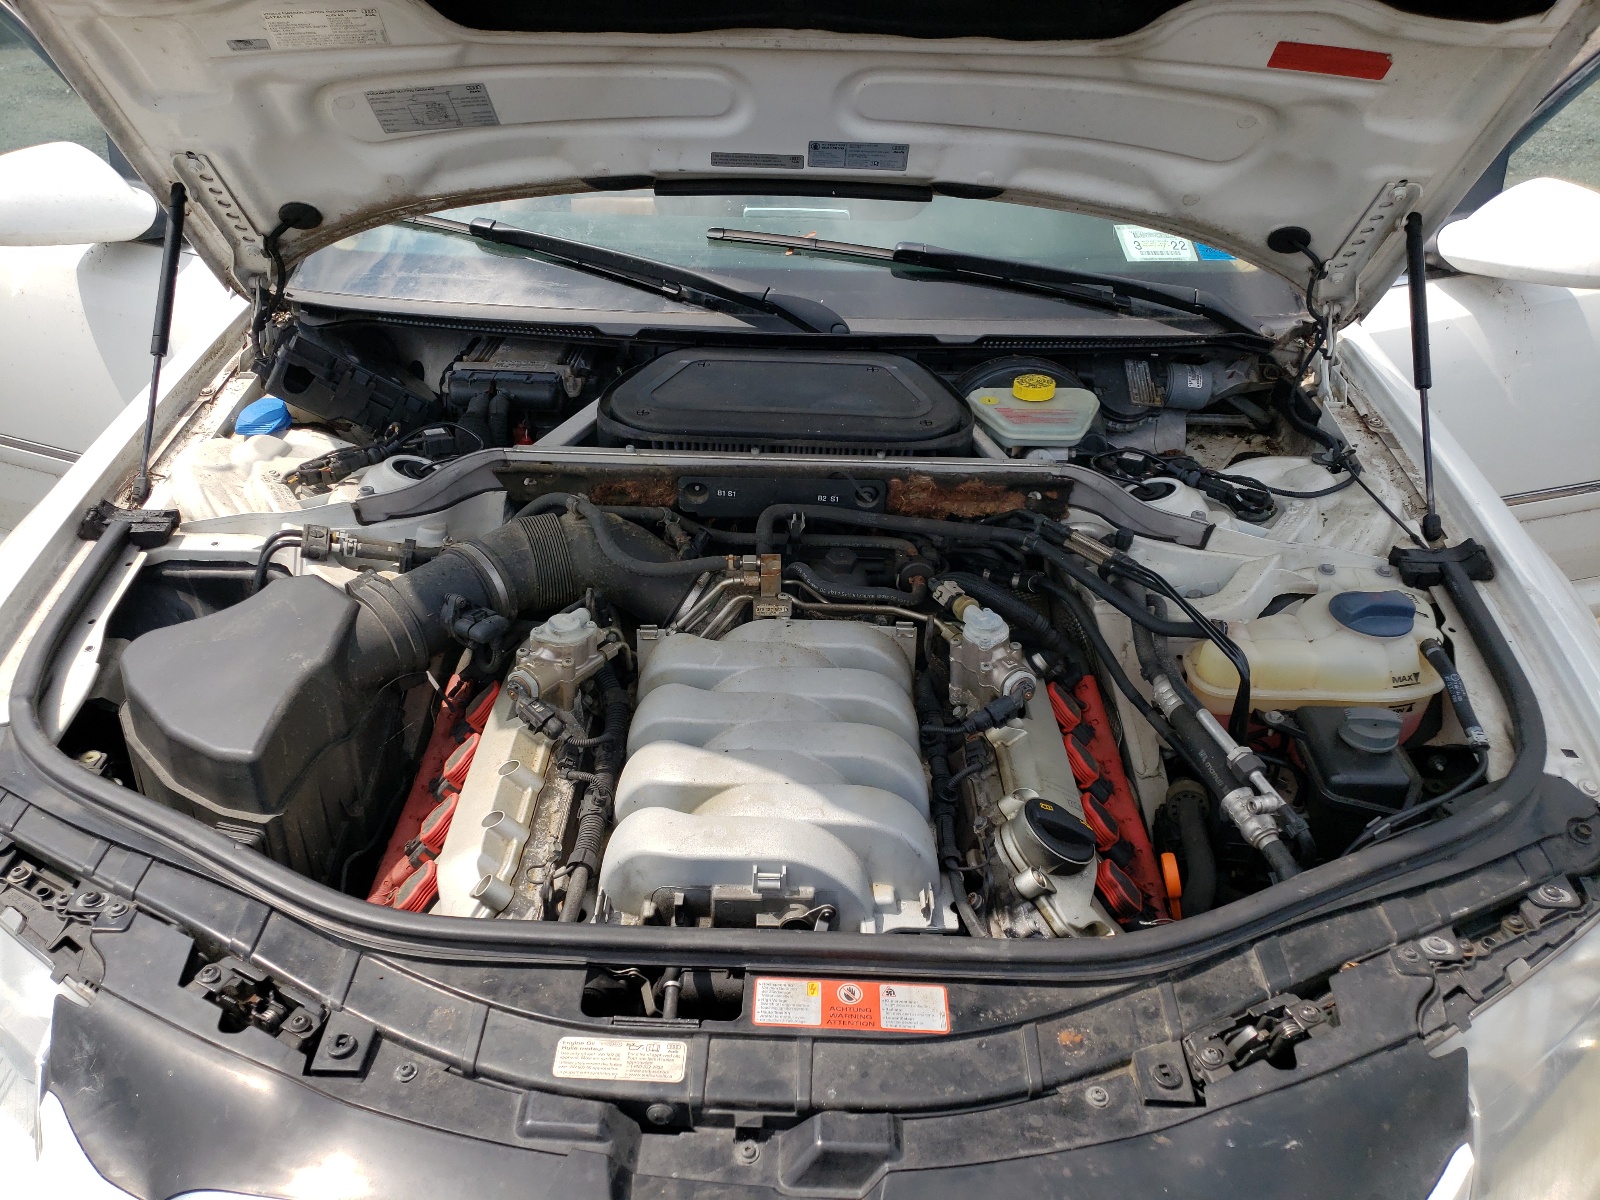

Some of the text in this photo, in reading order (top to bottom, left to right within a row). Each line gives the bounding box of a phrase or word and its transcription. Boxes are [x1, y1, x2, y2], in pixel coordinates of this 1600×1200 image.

[1134, 241, 1142, 250] 3
[1170, 241, 1187, 250] 22
[1392, 675, 1413, 683] MAX
